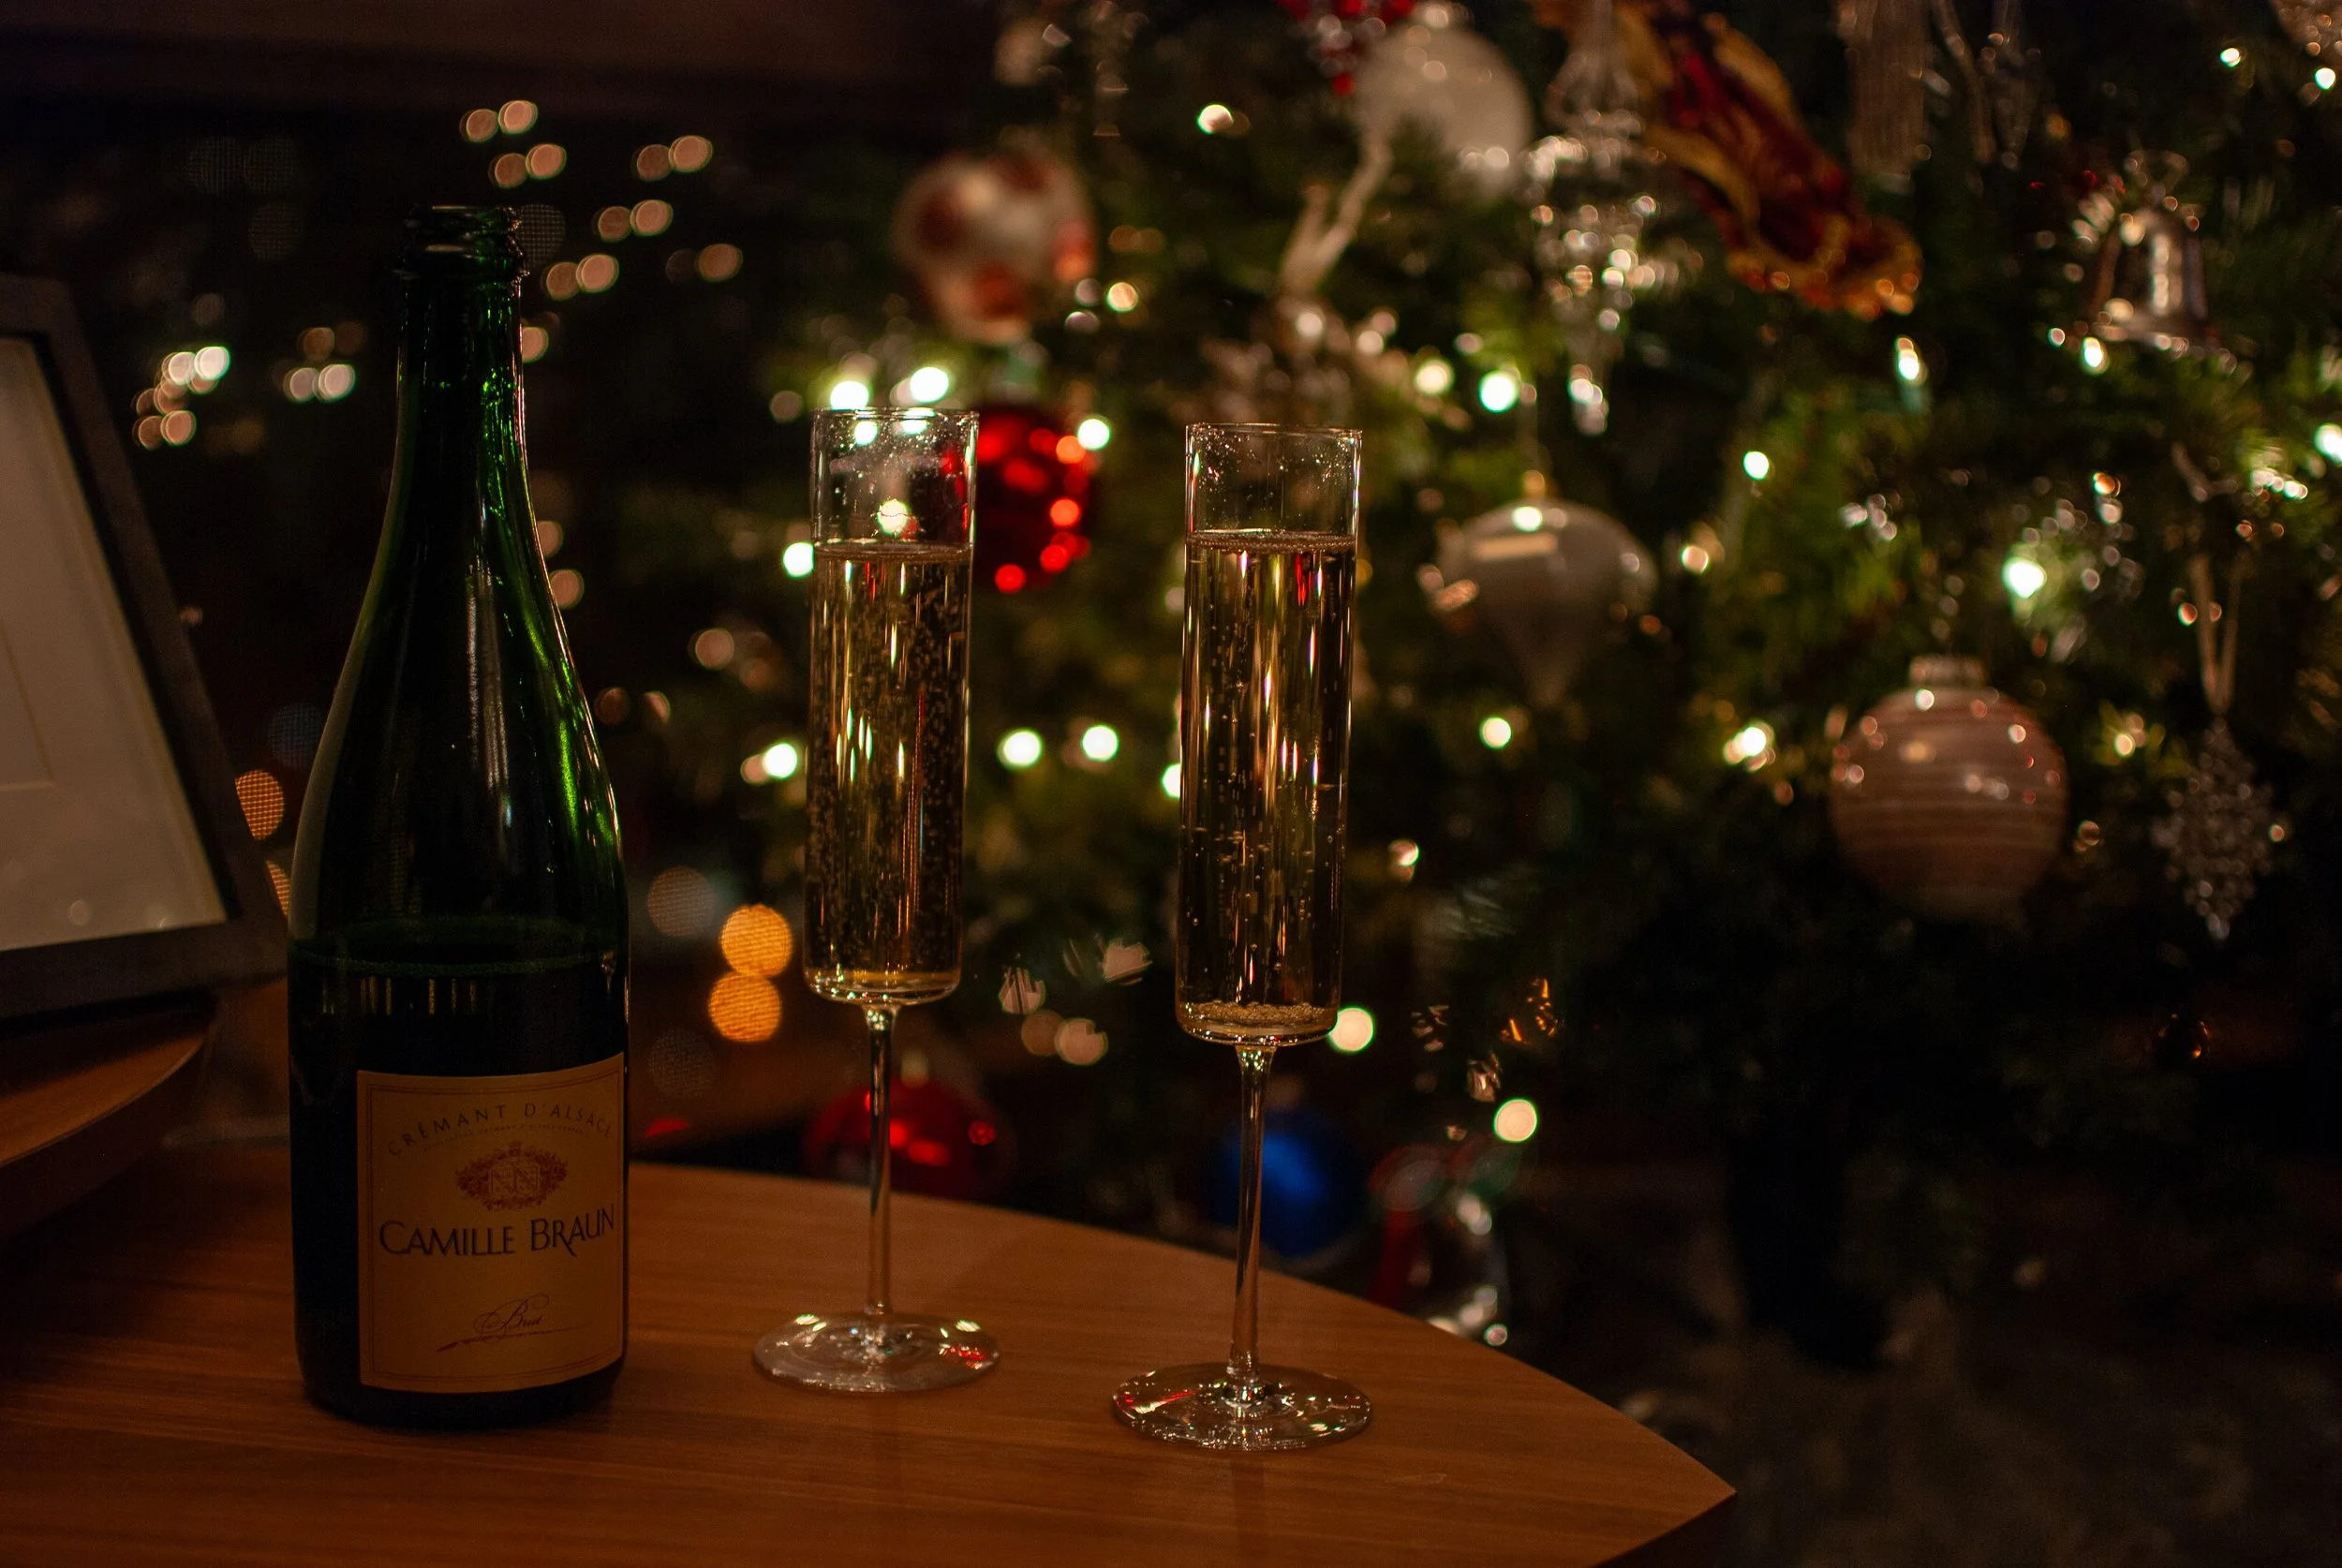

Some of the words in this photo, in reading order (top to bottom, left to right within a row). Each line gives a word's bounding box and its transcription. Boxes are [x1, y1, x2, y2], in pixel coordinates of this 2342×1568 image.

[378, 1220, 514, 1256] CAMILLE
[530, 1204, 615, 1257] BRAUN
[473, 1294, 550, 1342] Brut
